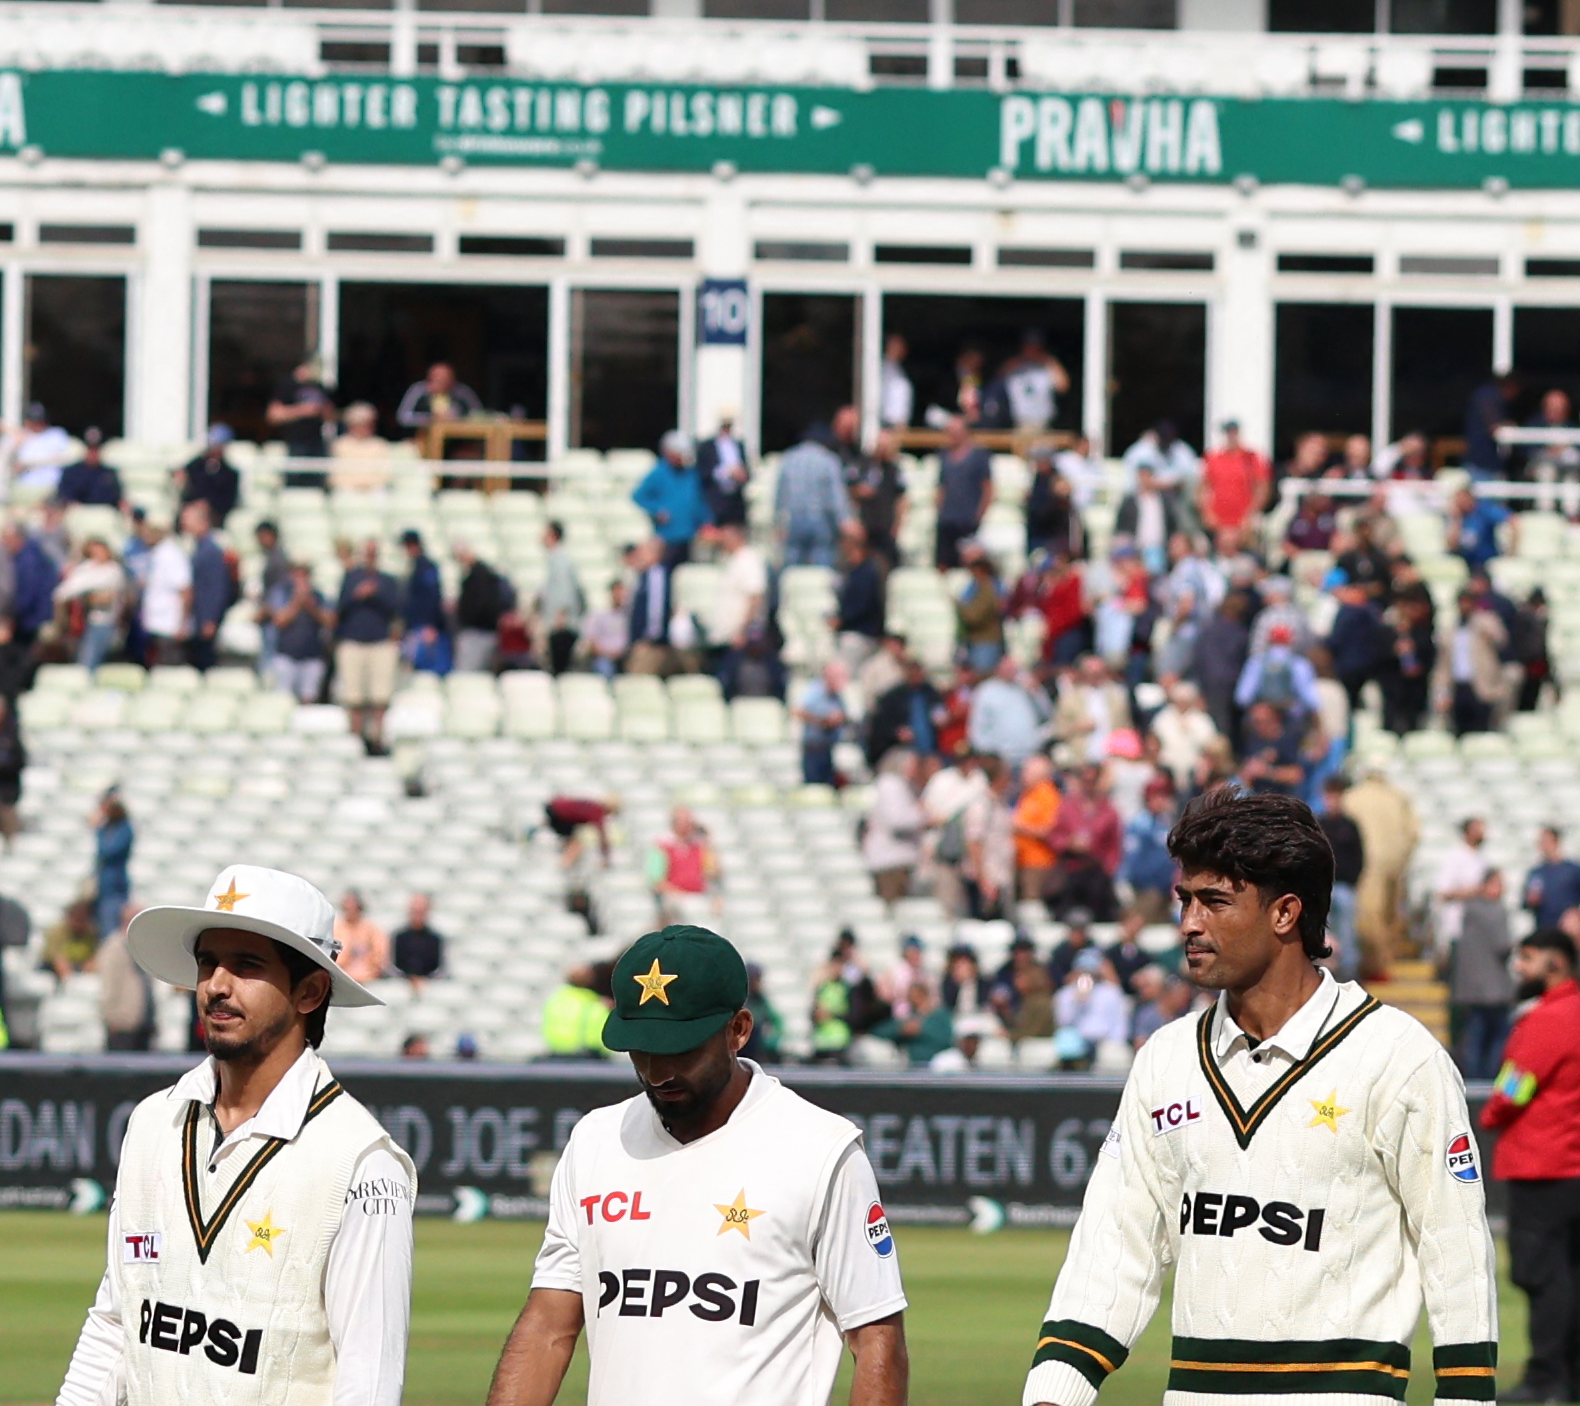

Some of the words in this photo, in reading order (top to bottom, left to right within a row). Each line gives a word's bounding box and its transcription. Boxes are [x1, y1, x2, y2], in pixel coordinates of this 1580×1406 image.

[242, 82, 416, 129] LIGHTER
[440, 86, 610, 134] TASTING
[625, 89, 798, 138] PILSNER
[1000, 96, 1223, 174] PRAVHA
[705, 286, 746, 334] 10
[1151, 1099, 1201, 1132] TCL
[442, 1109, 529, 1177] JOE
[1448, 1152, 1475, 1169] PEP
[363, 1198, 399, 1217] CITY
[580, 1191, 652, 1226] TCL
[125, 1235, 159, 1259] TCL
[868, 1222, 889, 1241] PEPS
